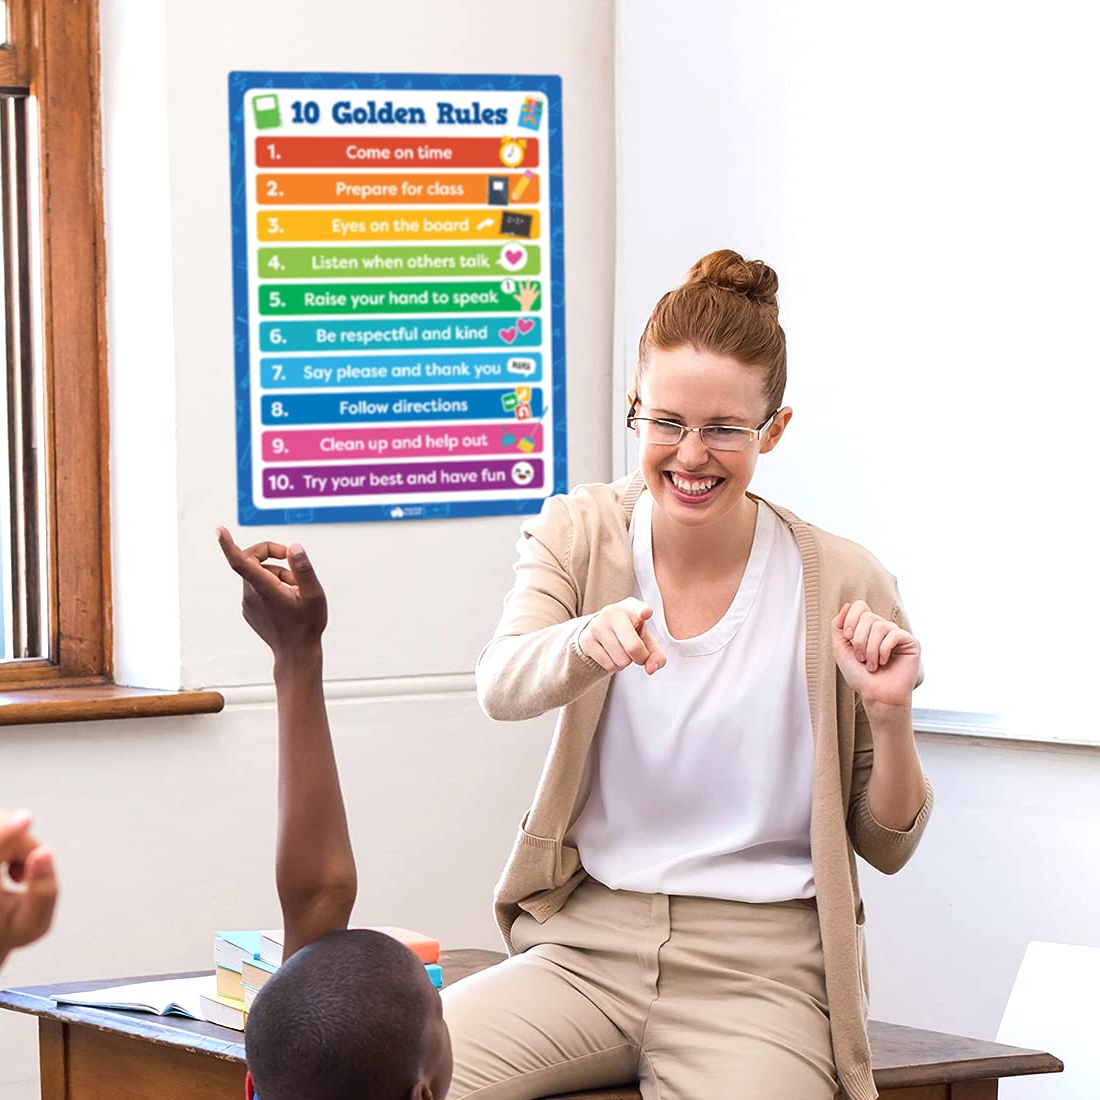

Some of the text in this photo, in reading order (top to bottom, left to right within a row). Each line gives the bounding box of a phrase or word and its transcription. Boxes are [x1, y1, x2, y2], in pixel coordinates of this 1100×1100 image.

[291, 101, 508, 125] 10 Golden Rules
[267, 144, 452, 160] 1. Come on time
[266, 180, 464, 199] 2. Prepare for class
[268, 217, 469, 236] 3. Eyes on the board
[267, 254, 490, 270] 4. Listen when others talk
[269, 290, 499, 308] 5. Raise your hand to speak
[270, 326, 488, 345] 6. Be respectful and kind
[272, 365, 286, 380] 7.
[304, 366, 332, 382] Say
[337, 365, 387, 382] please
[391, 363, 421, 377] and
[425, 362, 470, 376] thank
[474, 365, 501, 378] you
[271, 398, 468, 417] 8. Follow directions
[272, 434, 488, 454] 9. Clean up and help out
[268, 468, 506, 491] 10. Try your best and have fun
